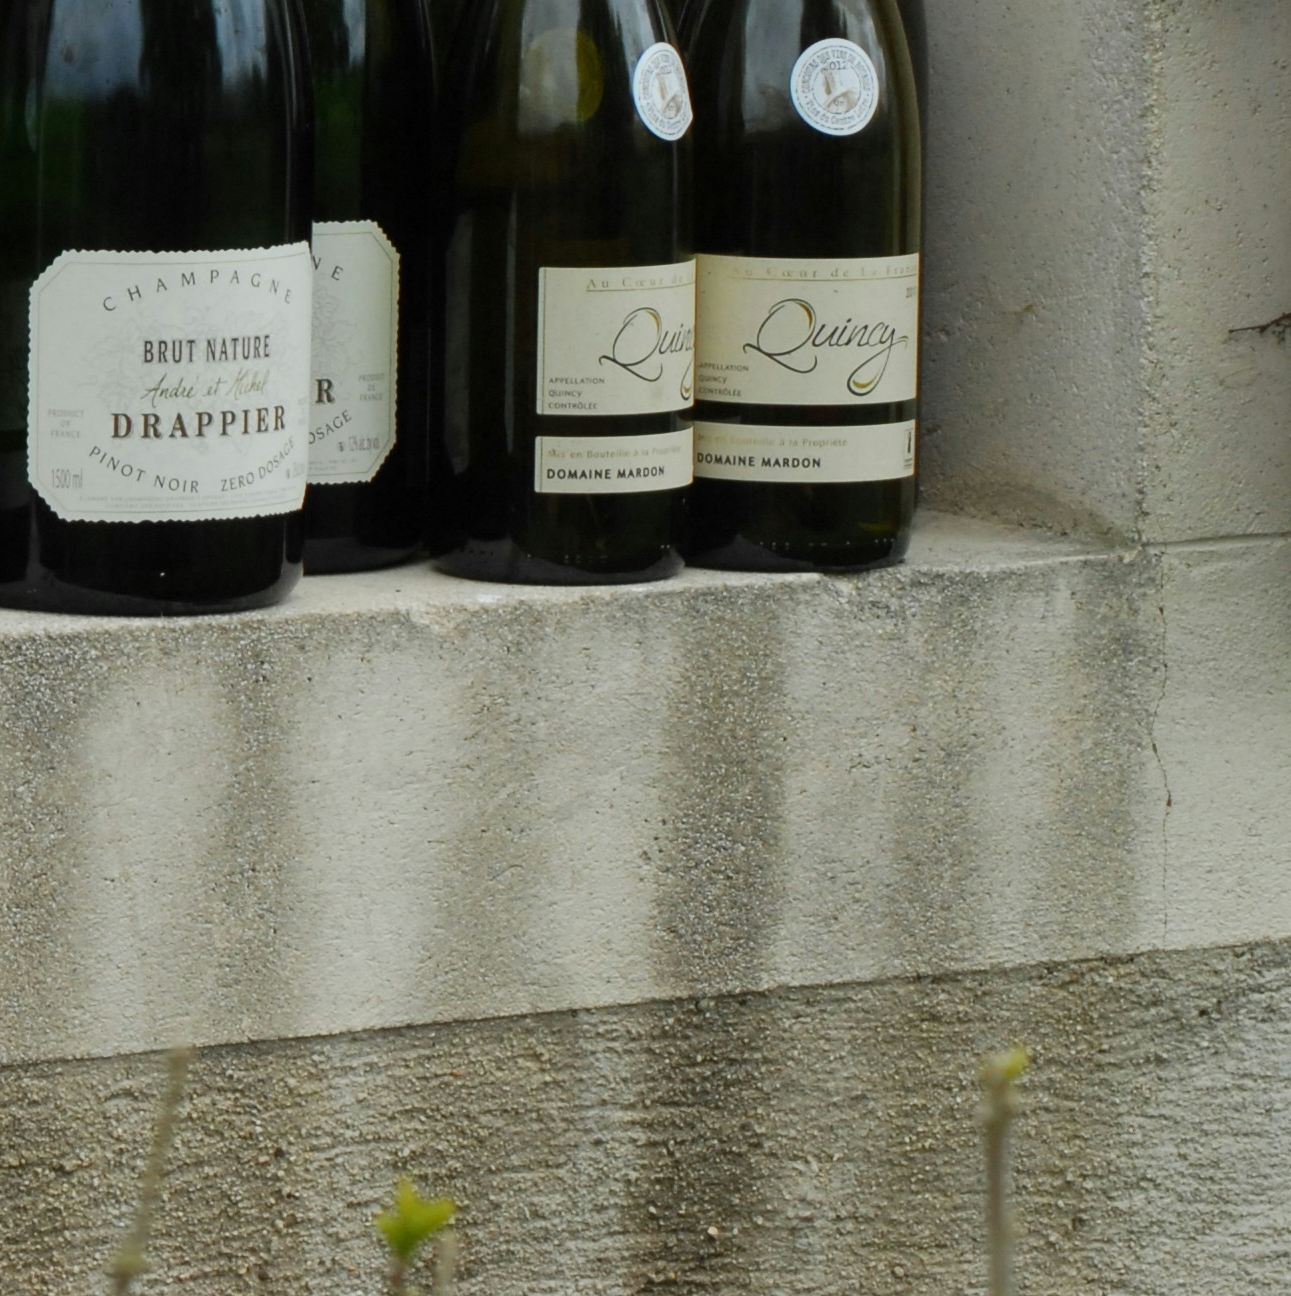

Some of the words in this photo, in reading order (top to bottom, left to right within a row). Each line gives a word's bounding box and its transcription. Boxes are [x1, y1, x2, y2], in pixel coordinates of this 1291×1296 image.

[830, 267, 849, 278] de
[103, 268, 293, 312] CHAMPAGNE
[587, 278, 609, 288] Au
[143, 340, 195, 364] BRUT
[206, 334, 271, 362] NATURE
[742, 298, 909, 396] Quincy
[698, 362, 749, 372] APPELLATION
[698, 375, 728, 384] QUINCY
[140, 371, 197, 409] André
[549, 390, 582, 398] QUINCY
[549, 401, 598, 410] CONTRÔLÉE
[110, 404, 286, 440] DRAPPIER
[221, 471, 255, 493] ZERO
[258, 436, 295, 481] DOSAGE
[697, 452, 755, 467] DOMAINE
[761, 457, 821, 469] MARDON
[89, 446, 147, 482] PINOT
[153, 474, 200, 494] NOIR
[547, 468, 612, 480] DOMAINE
[617, 466, 665, 479] MARDON
